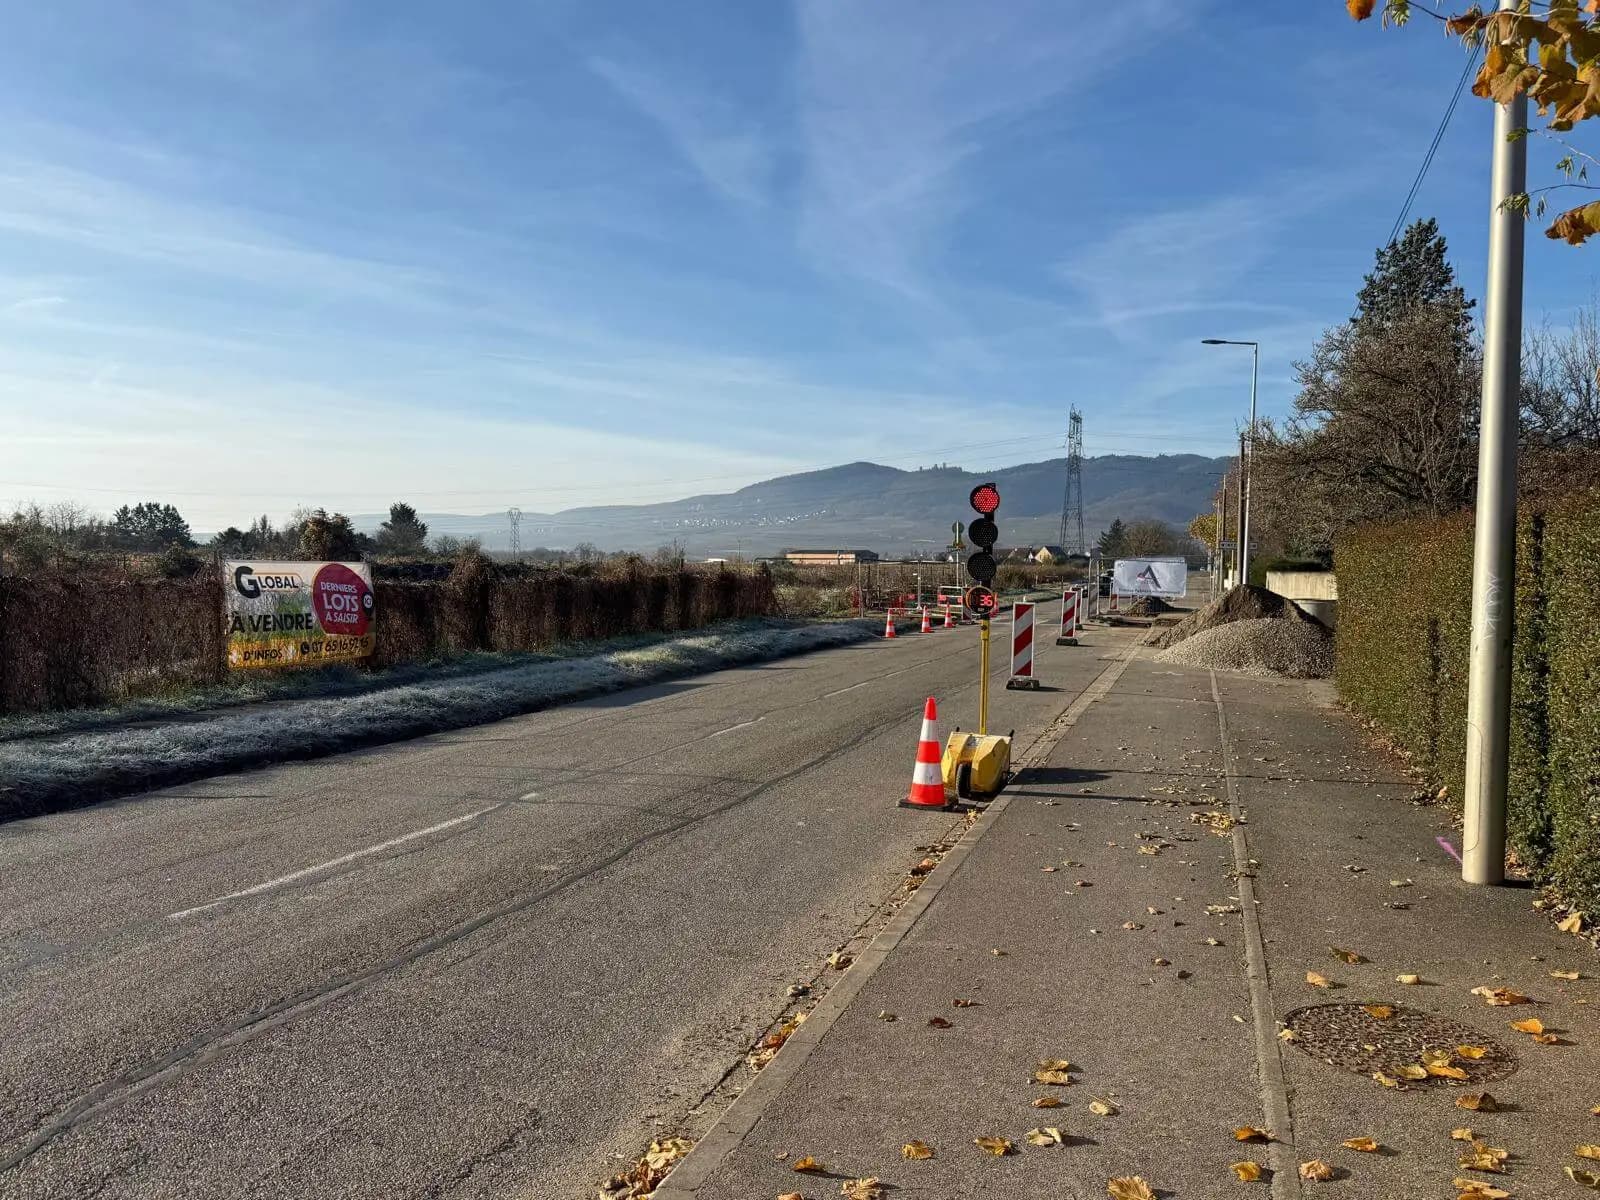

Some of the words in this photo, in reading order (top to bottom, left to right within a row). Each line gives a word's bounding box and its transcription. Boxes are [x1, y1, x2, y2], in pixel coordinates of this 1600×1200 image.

[235, 566, 299, 599] GLOBAL
[320, 581, 358, 593] DERNIERS
[323, 593, 359, 612] LOTS
[248, 612, 313, 633] VENDRE
[333, 612, 359, 624] SAISIR
[312, 641, 323, 653] 07
